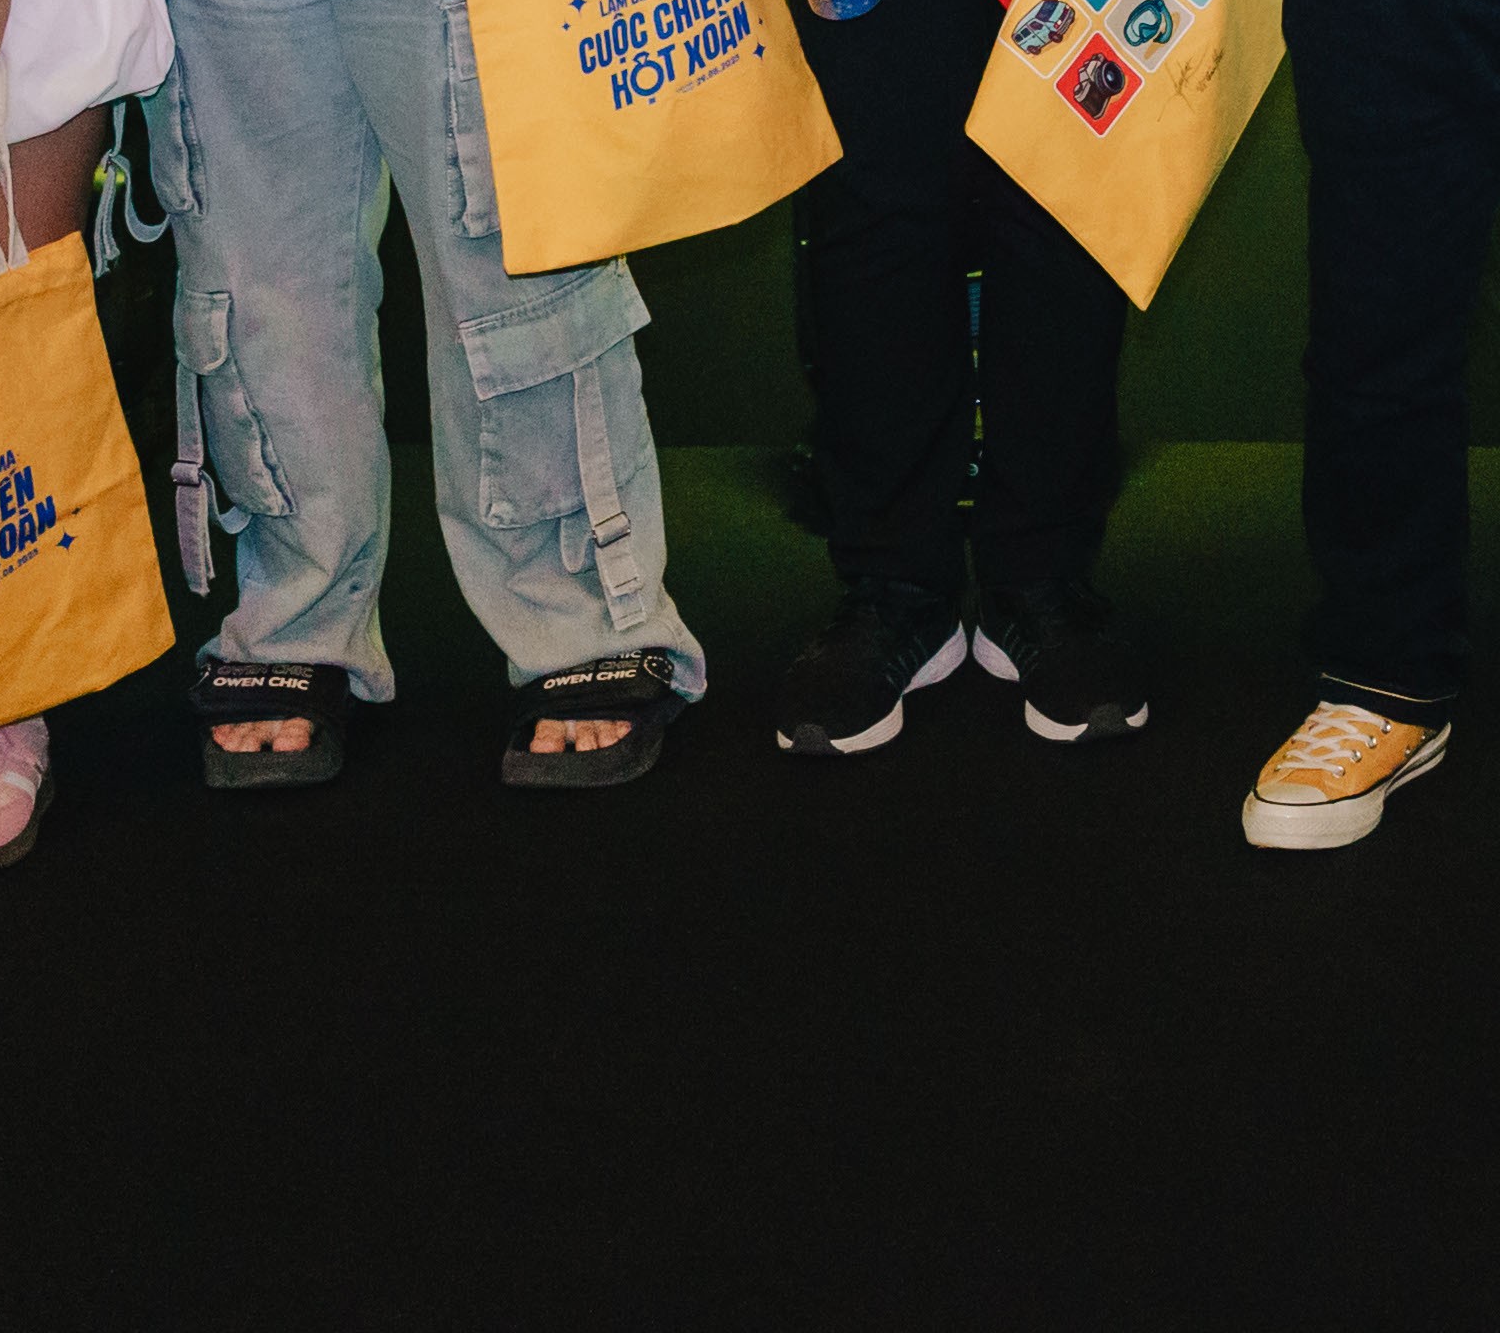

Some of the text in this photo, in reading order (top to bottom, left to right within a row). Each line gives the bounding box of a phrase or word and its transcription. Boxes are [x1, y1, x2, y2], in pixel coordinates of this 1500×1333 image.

[579, 16, 649, 75] CUỘC
[684, 0, 751, 76] XOÀN
[213, 676, 310, 691] OWEN CHIC
[543, 669, 637, 690] OWEN CHIC
